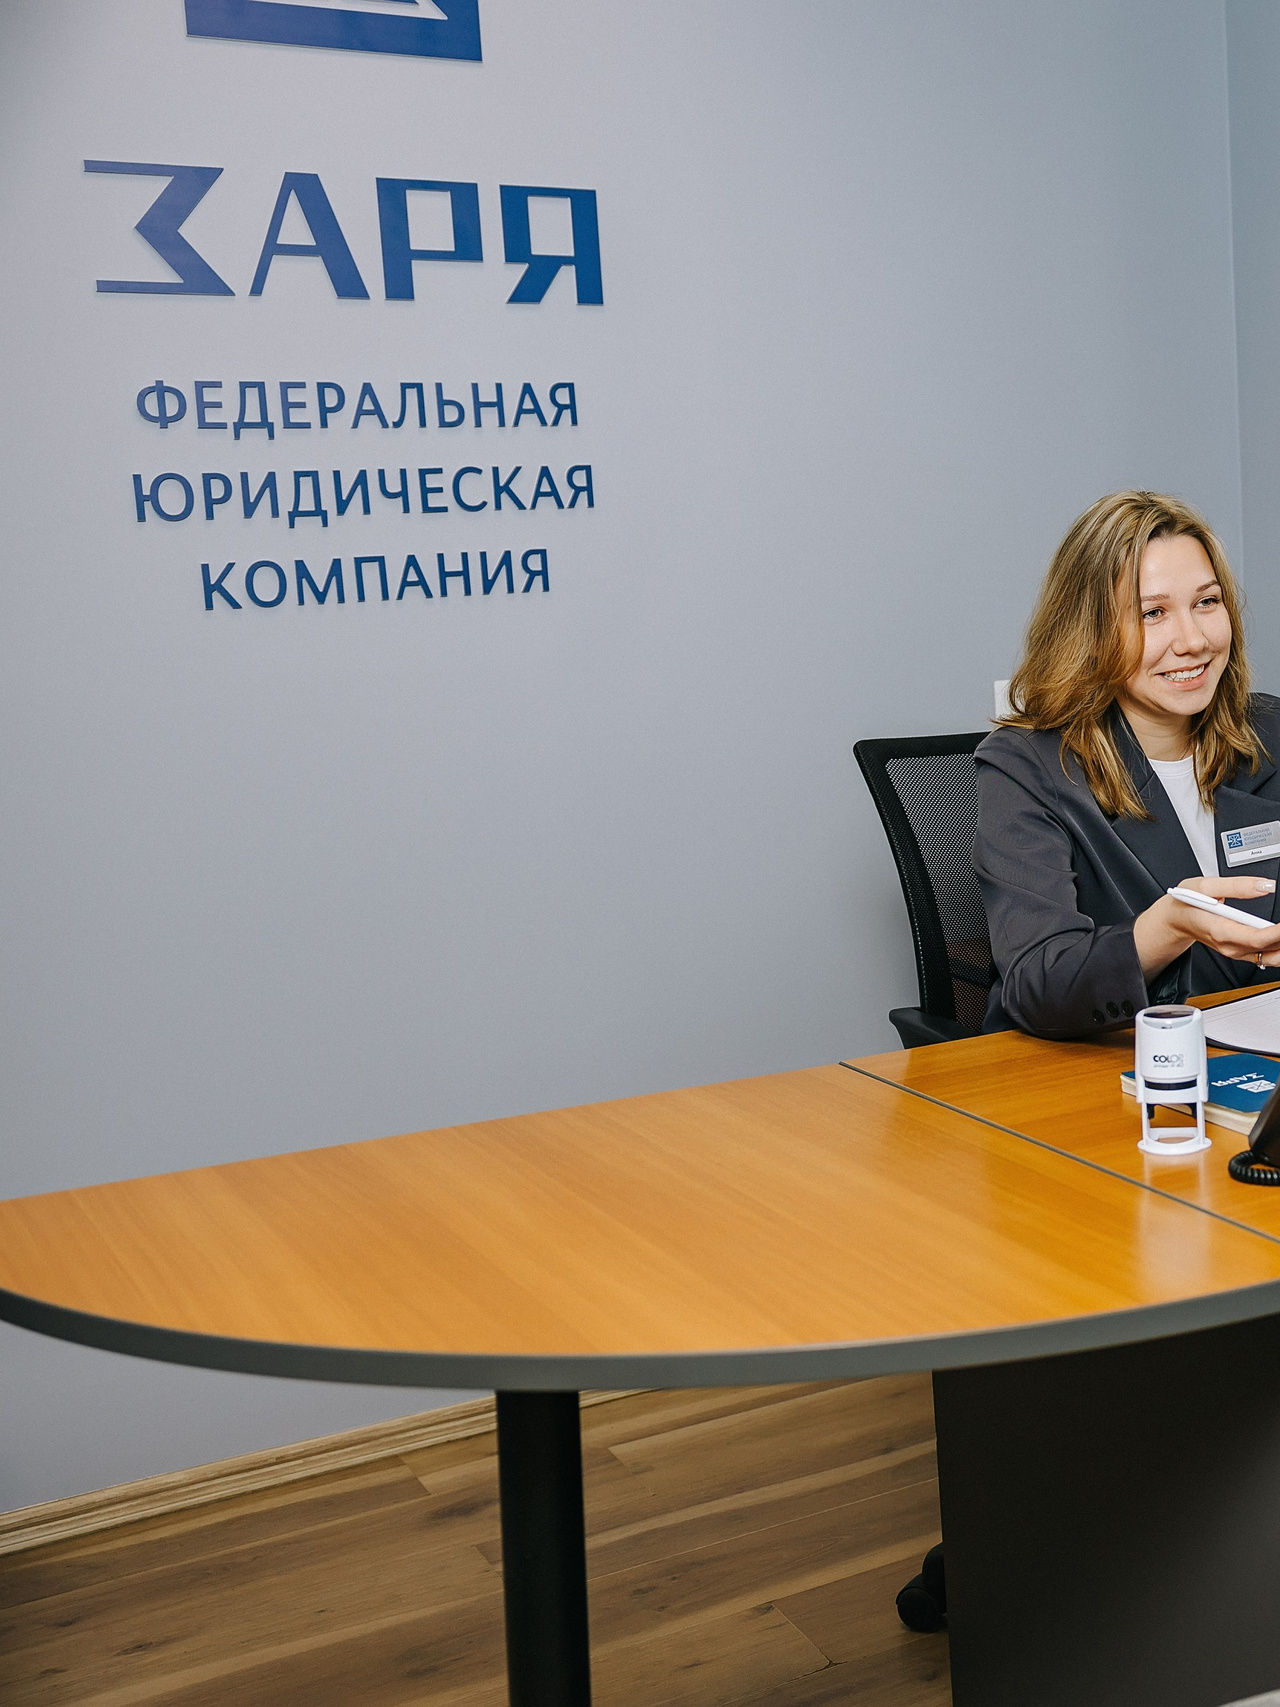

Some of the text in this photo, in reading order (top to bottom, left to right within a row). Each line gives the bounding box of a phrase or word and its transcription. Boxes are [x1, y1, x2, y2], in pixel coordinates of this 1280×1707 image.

[83, 159, 604, 306] ЗАРЯ
[136, 380, 578, 440] ФЕДЕРАЛЬНАЯ
[132, 465, 594, 528] ЮРИДИЧЕСКАЯ
[200, 548, 550, 611] КОМПАНИЯ
